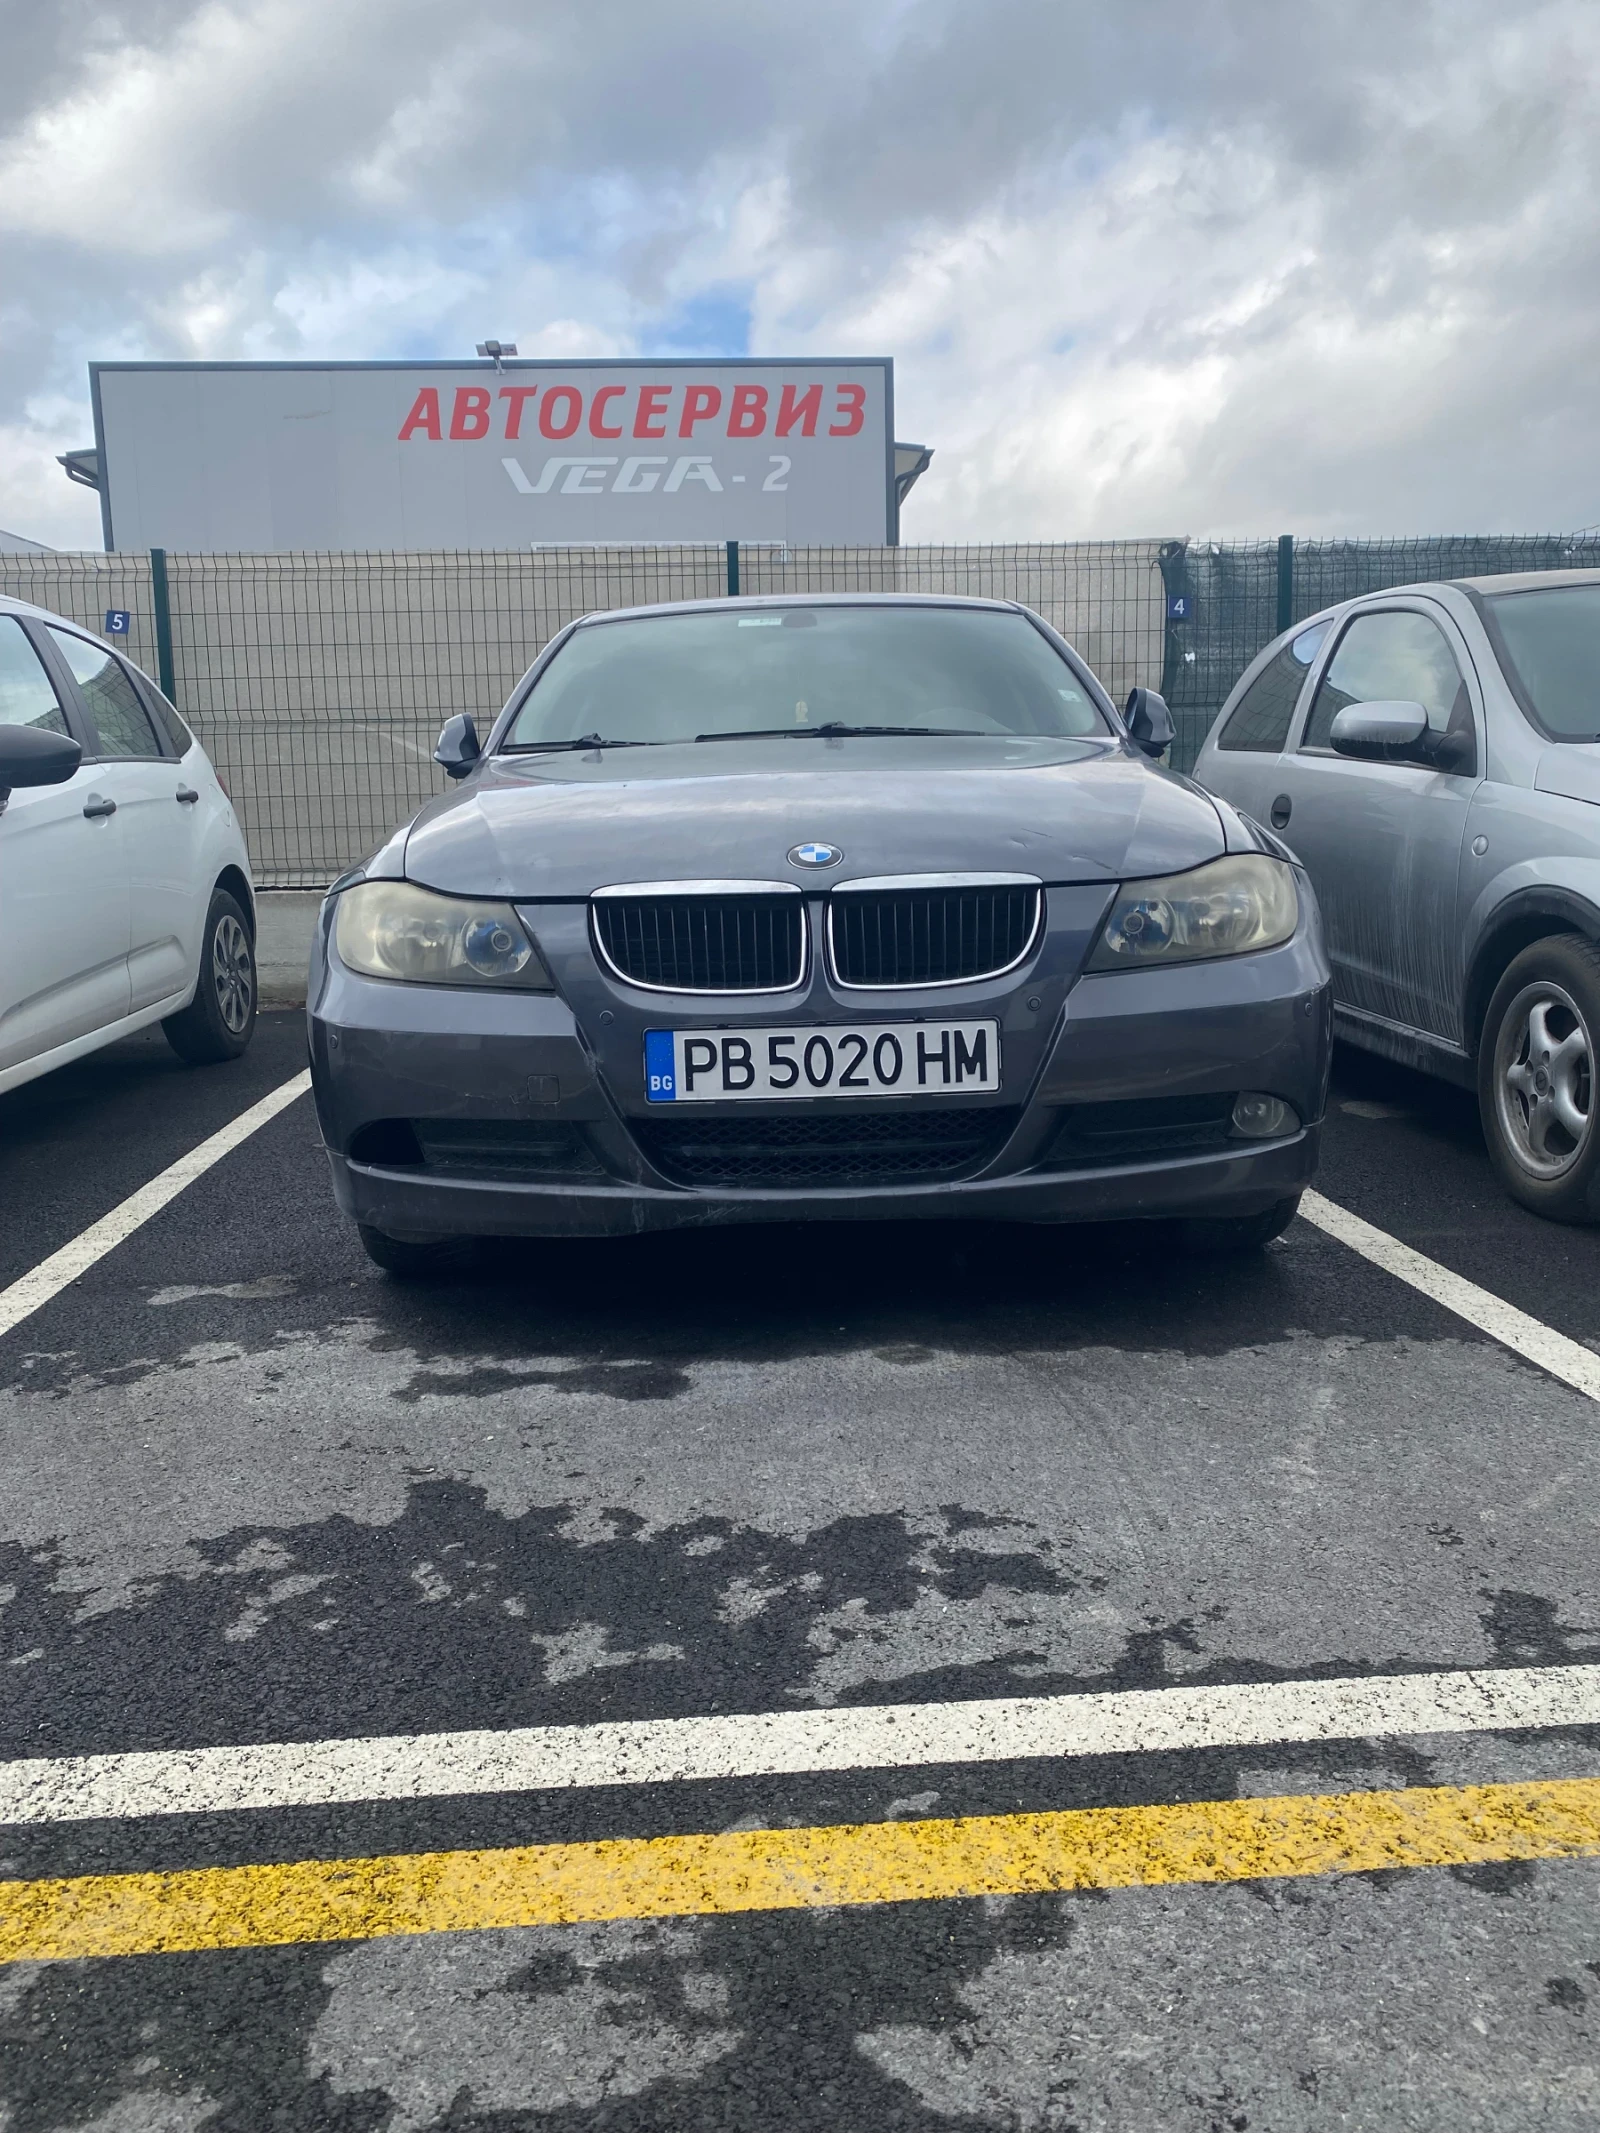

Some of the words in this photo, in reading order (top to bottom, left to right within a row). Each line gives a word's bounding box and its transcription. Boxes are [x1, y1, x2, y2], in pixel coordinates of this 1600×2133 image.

[397, 384, 867, 441] АВТОСЕРВИЗ
[1173, 598, 1185, 615] 4
[111, 613, 124, 630] 5
[767, 1032, 904, 1090] 5020
[650, 1075, 673, 1091] BG
